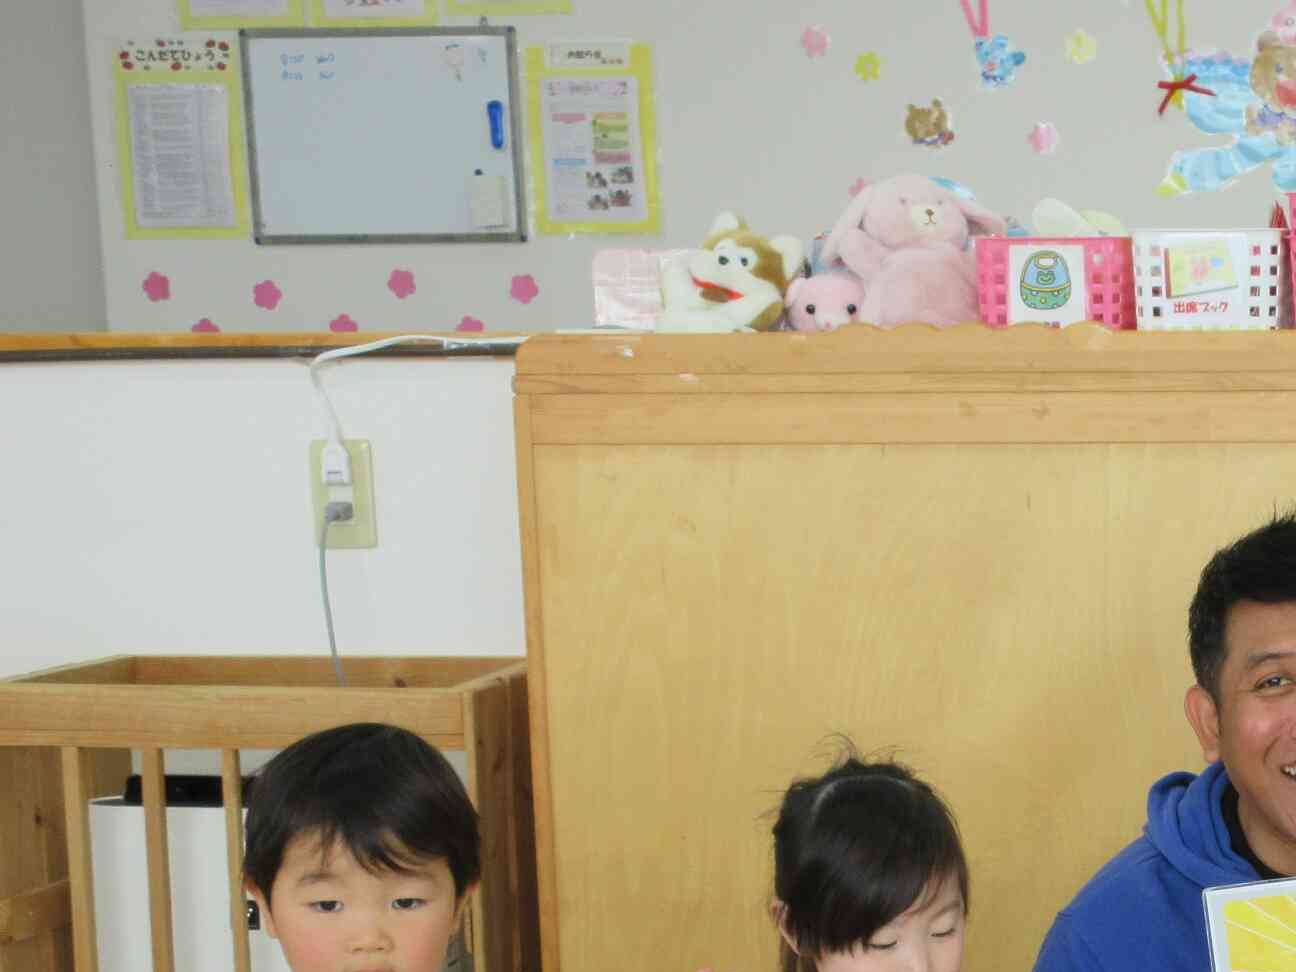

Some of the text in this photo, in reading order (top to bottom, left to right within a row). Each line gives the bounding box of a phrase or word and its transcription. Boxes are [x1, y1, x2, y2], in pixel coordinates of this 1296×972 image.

[1174, 300, 1230, 314] 出席ブック
